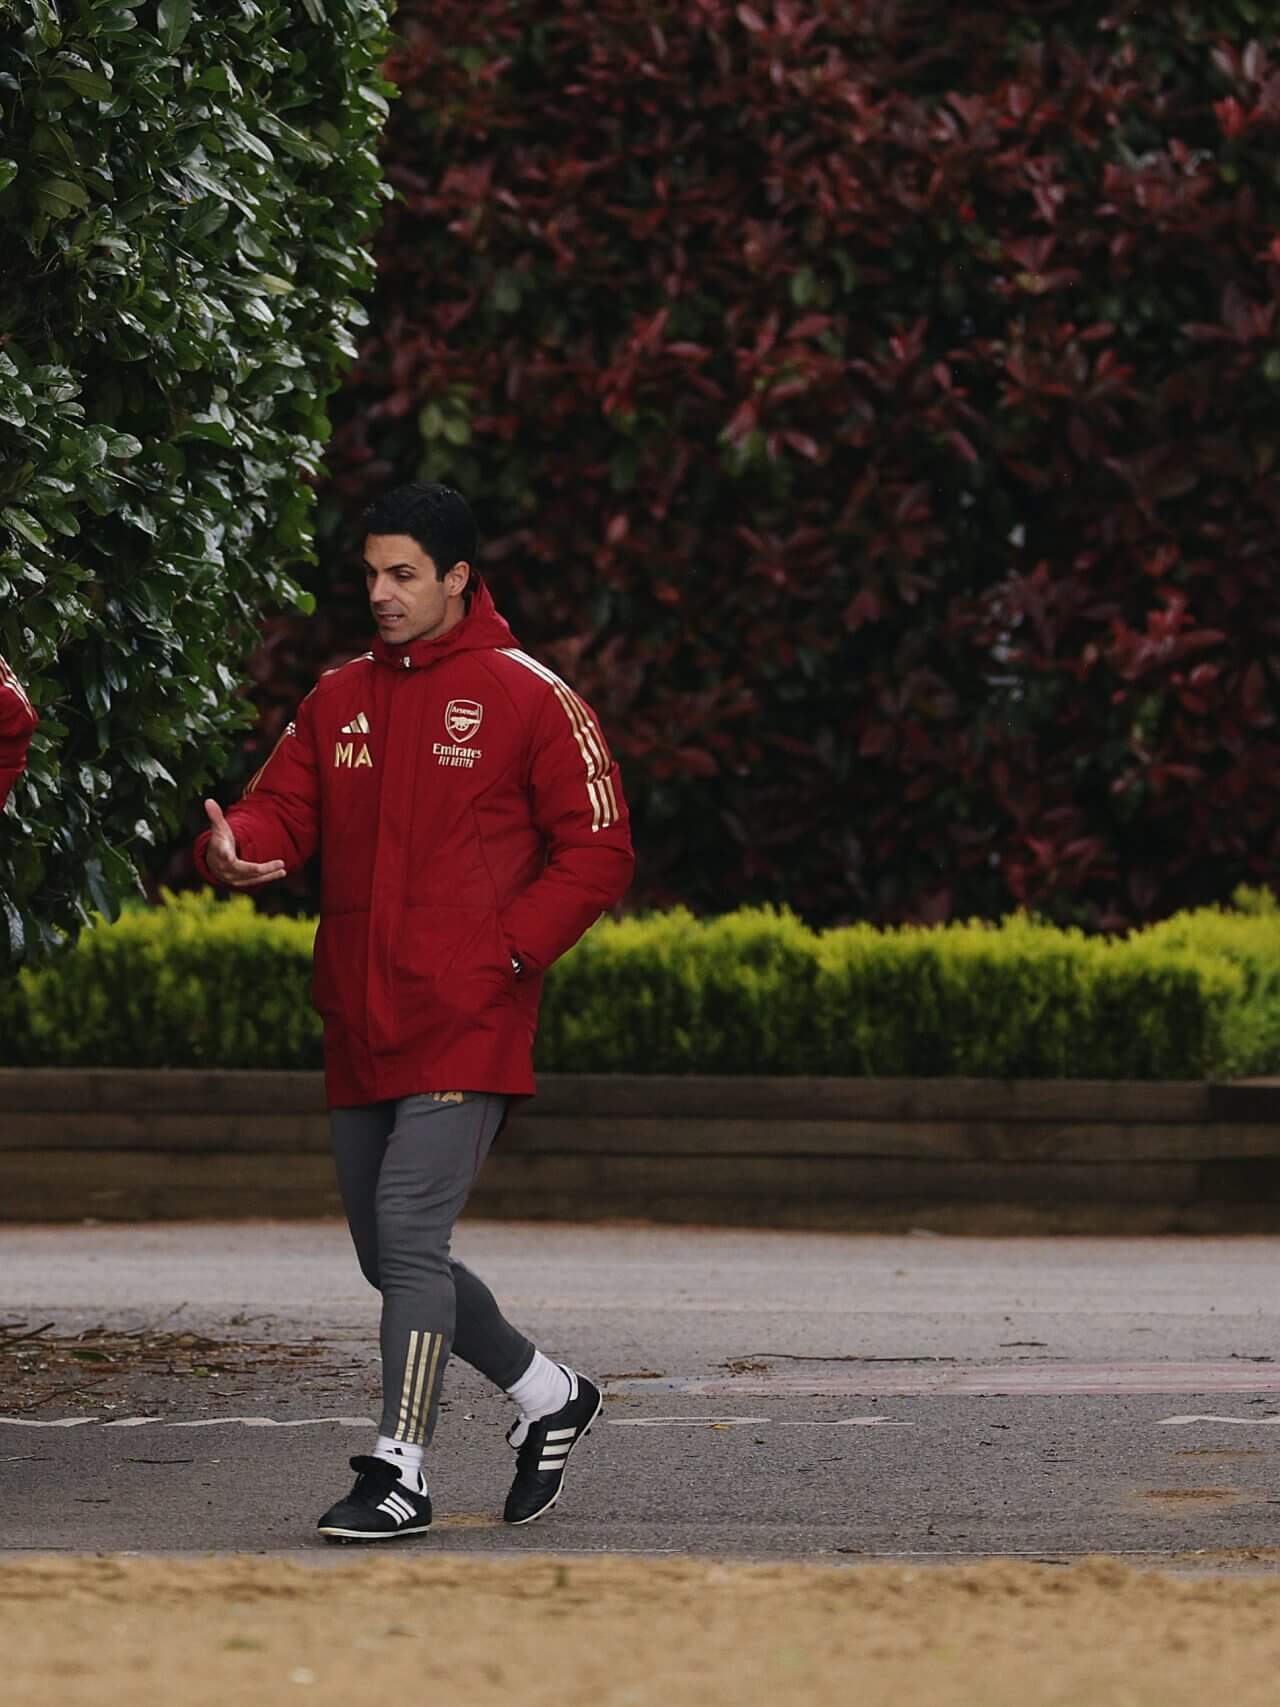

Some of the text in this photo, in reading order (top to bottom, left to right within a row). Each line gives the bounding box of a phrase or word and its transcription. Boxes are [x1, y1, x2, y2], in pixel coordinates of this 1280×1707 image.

[451, 706, 480, 716] Arsenal
[334, 742, 373, 768] MA
[432, 743, 482, 759] Emirates
[438, 755, 474, 768] FLY BETTER
